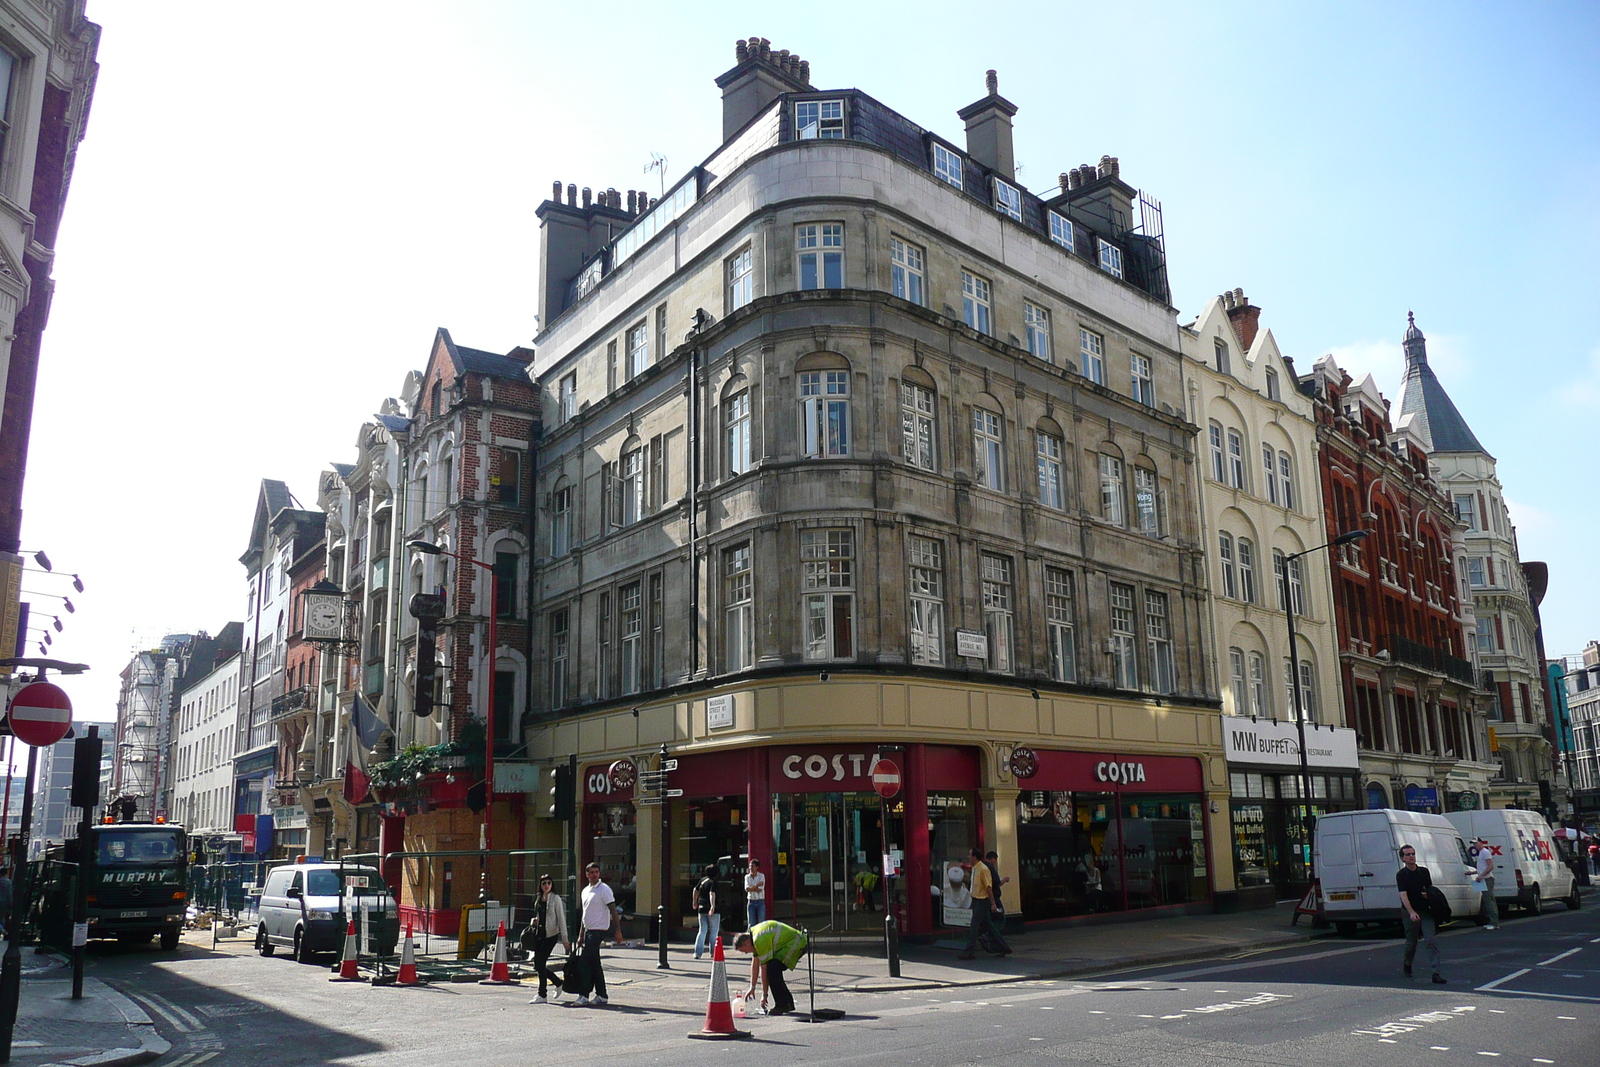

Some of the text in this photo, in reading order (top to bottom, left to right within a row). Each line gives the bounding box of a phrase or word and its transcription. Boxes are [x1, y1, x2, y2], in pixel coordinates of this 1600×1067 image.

[310, 596, 340, 608] COSTUMIER
[1232, 730, 1257, 752] MW
[1259, 738, 1289, 754] BUFFET
[1013, 750, 1030, 759] COSTA
[615, 763, 632, 771] COSTA
[1012, 765, 1032, 776] COFFEE
[1097, 761, 1146, 785] COSTA
[588, 773, 617, 795] COS
[614, 777, 634, 788] COFFEE
[1517, 830, 1554, 861] FedEx
[102, 872, 166, 883] MURPHY
